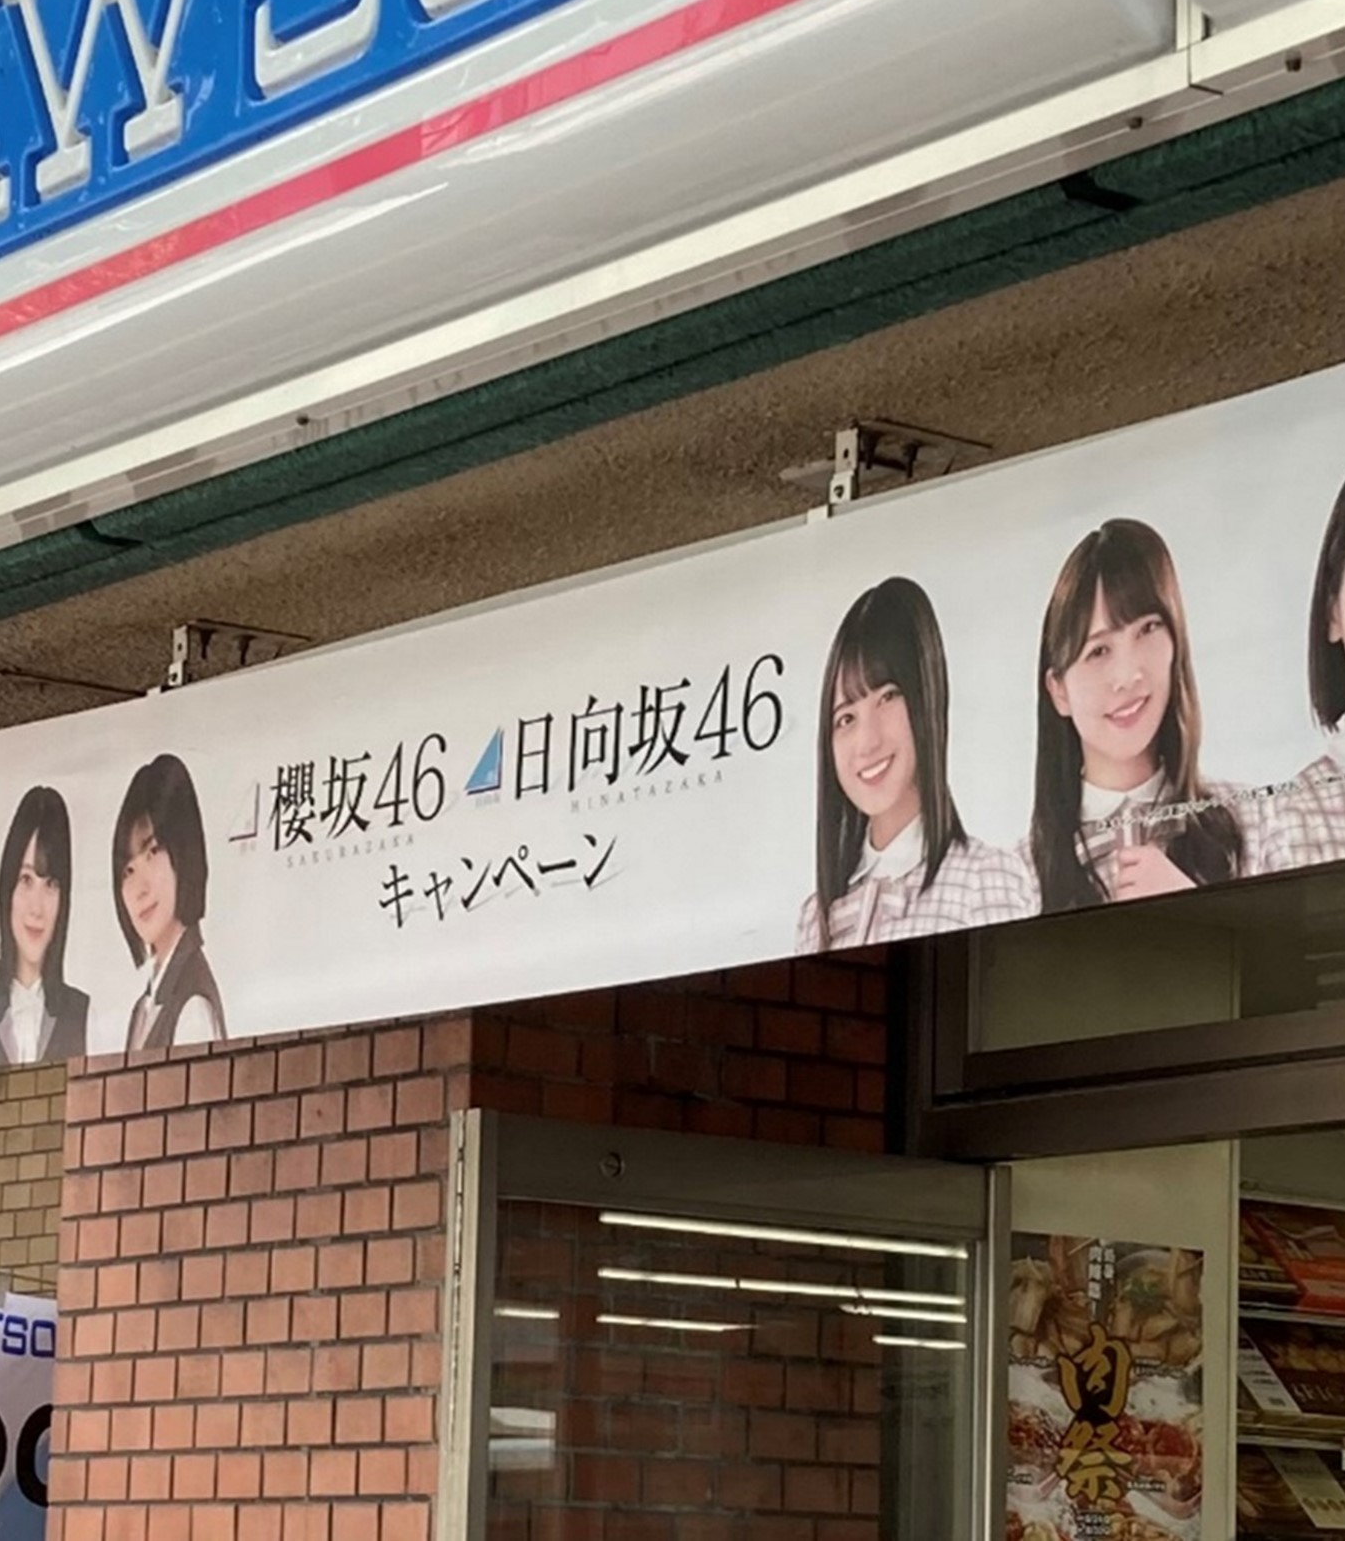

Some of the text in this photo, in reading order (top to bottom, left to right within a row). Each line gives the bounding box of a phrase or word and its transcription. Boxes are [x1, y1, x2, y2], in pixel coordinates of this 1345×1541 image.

[513, 653, 786, 801] 日向坂46
[570, 769, 724, 814] HINATAZAKA
[378, 833, 619, 929] キャンペーン
